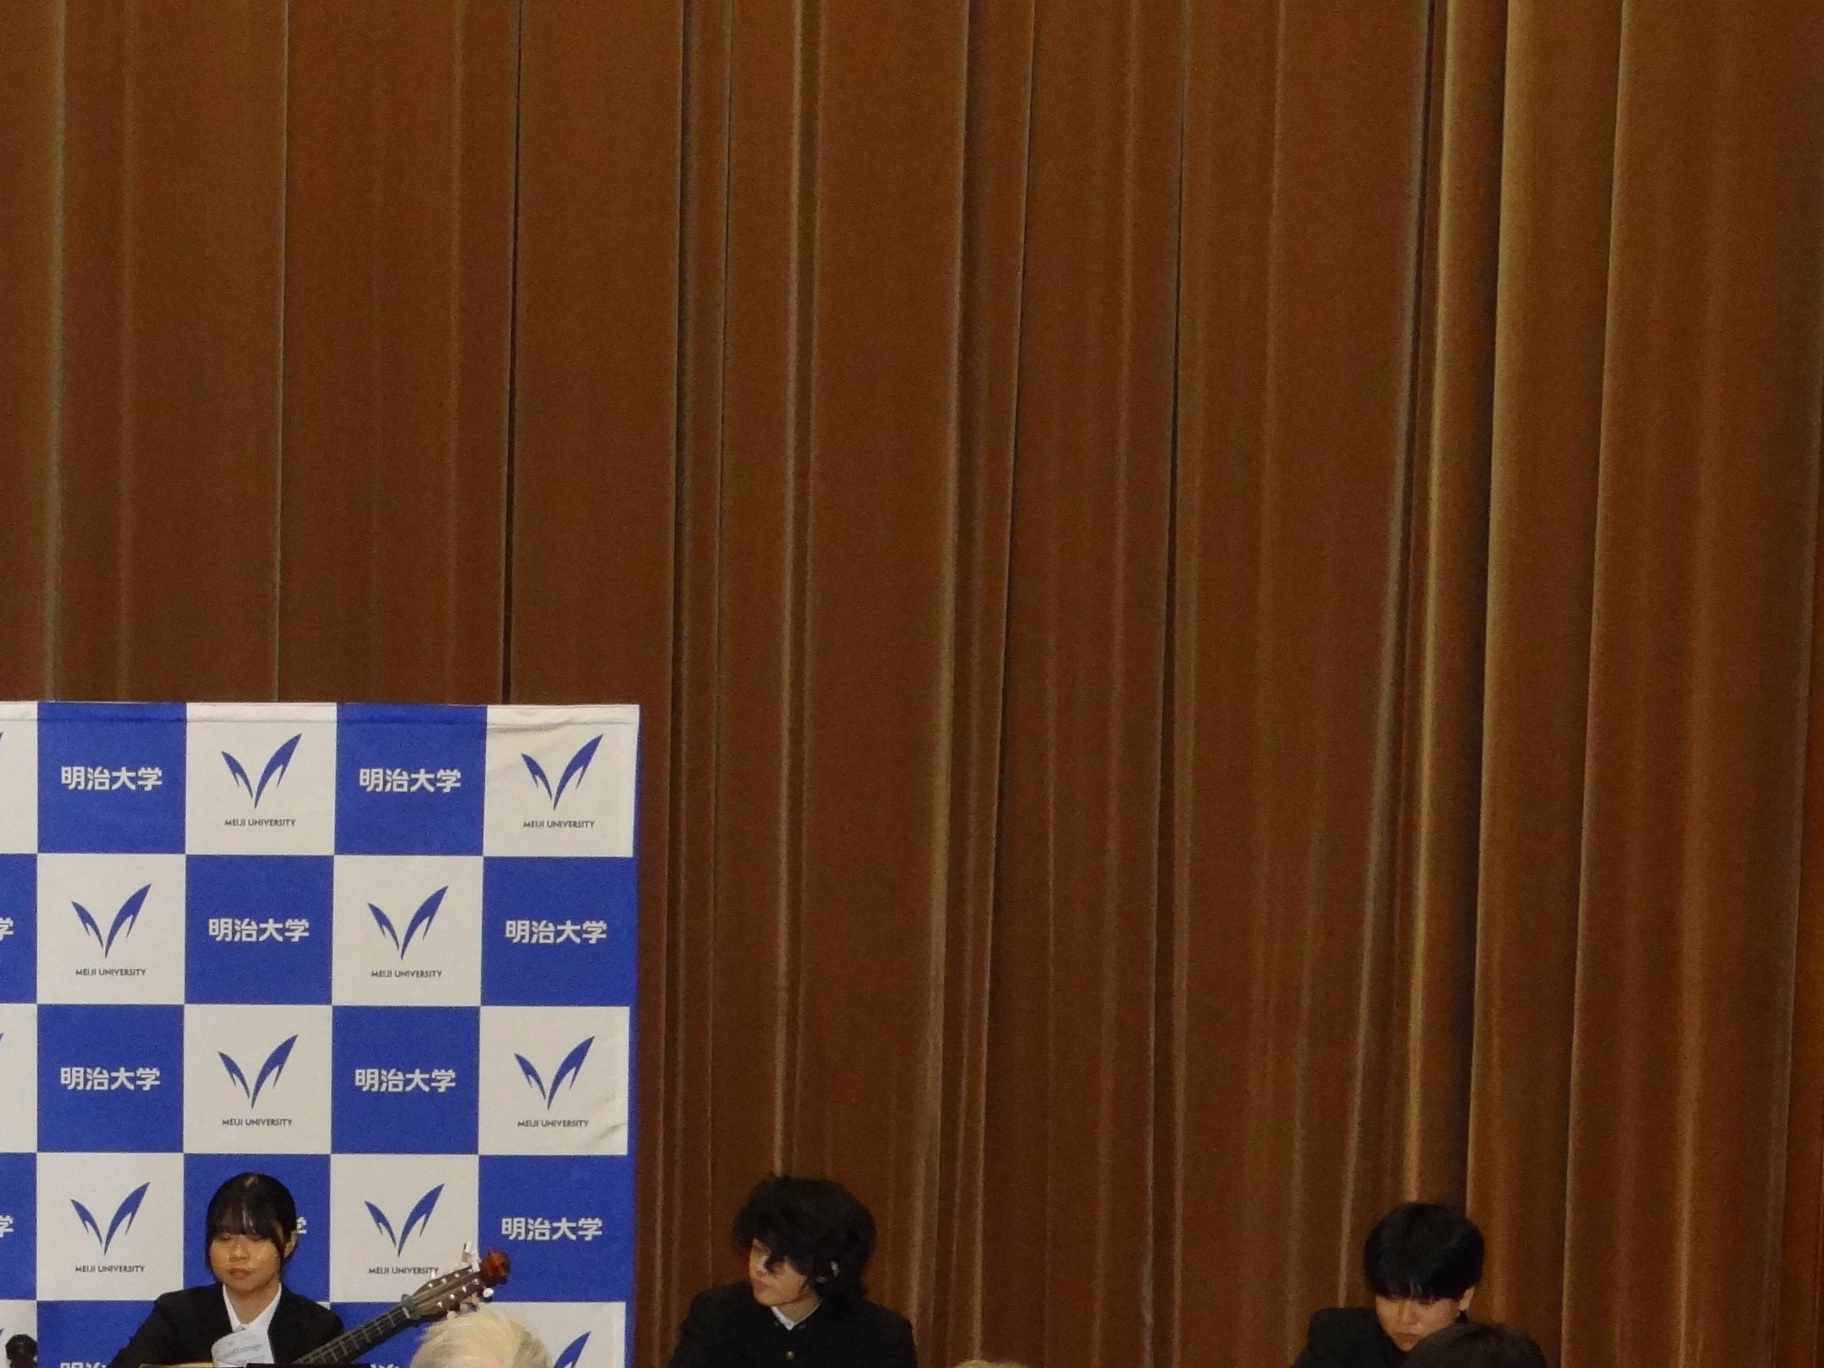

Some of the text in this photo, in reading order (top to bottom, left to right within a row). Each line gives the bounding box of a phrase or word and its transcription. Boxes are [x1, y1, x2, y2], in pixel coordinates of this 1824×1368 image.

[60, 766, 163, 792] 明治大学
[359, 767, 462, 793] 明治大学
[224, 818, 296, 827] MEIJI UNIVERSITY
[522, 820, 595, 829] MEIJI UNIVERSITY
[208, 917, 310, 943] 明治大学
[505, 919, 607, 944] 明治大学
[75, 968, 147, 977] MEIJI UNIVERSITY
[370, 969, 443, 979] MEIJI UNIVERSITY
[60, 1066, 161, 1091] 明治大学
[354, 1068, 456, 1093] 明治大学
[221, 1118, 293, 1127] MEIJI UNIVERSITY
[517, 1119, 589, 1128] MEIJI UNIVERSITY
[501, 1217, 603, 1241] 明治大学
[74, 1265, 146, 1273] MEIJI UNIVERSITY
[368, 1265, 390, 1276] MEIJI
